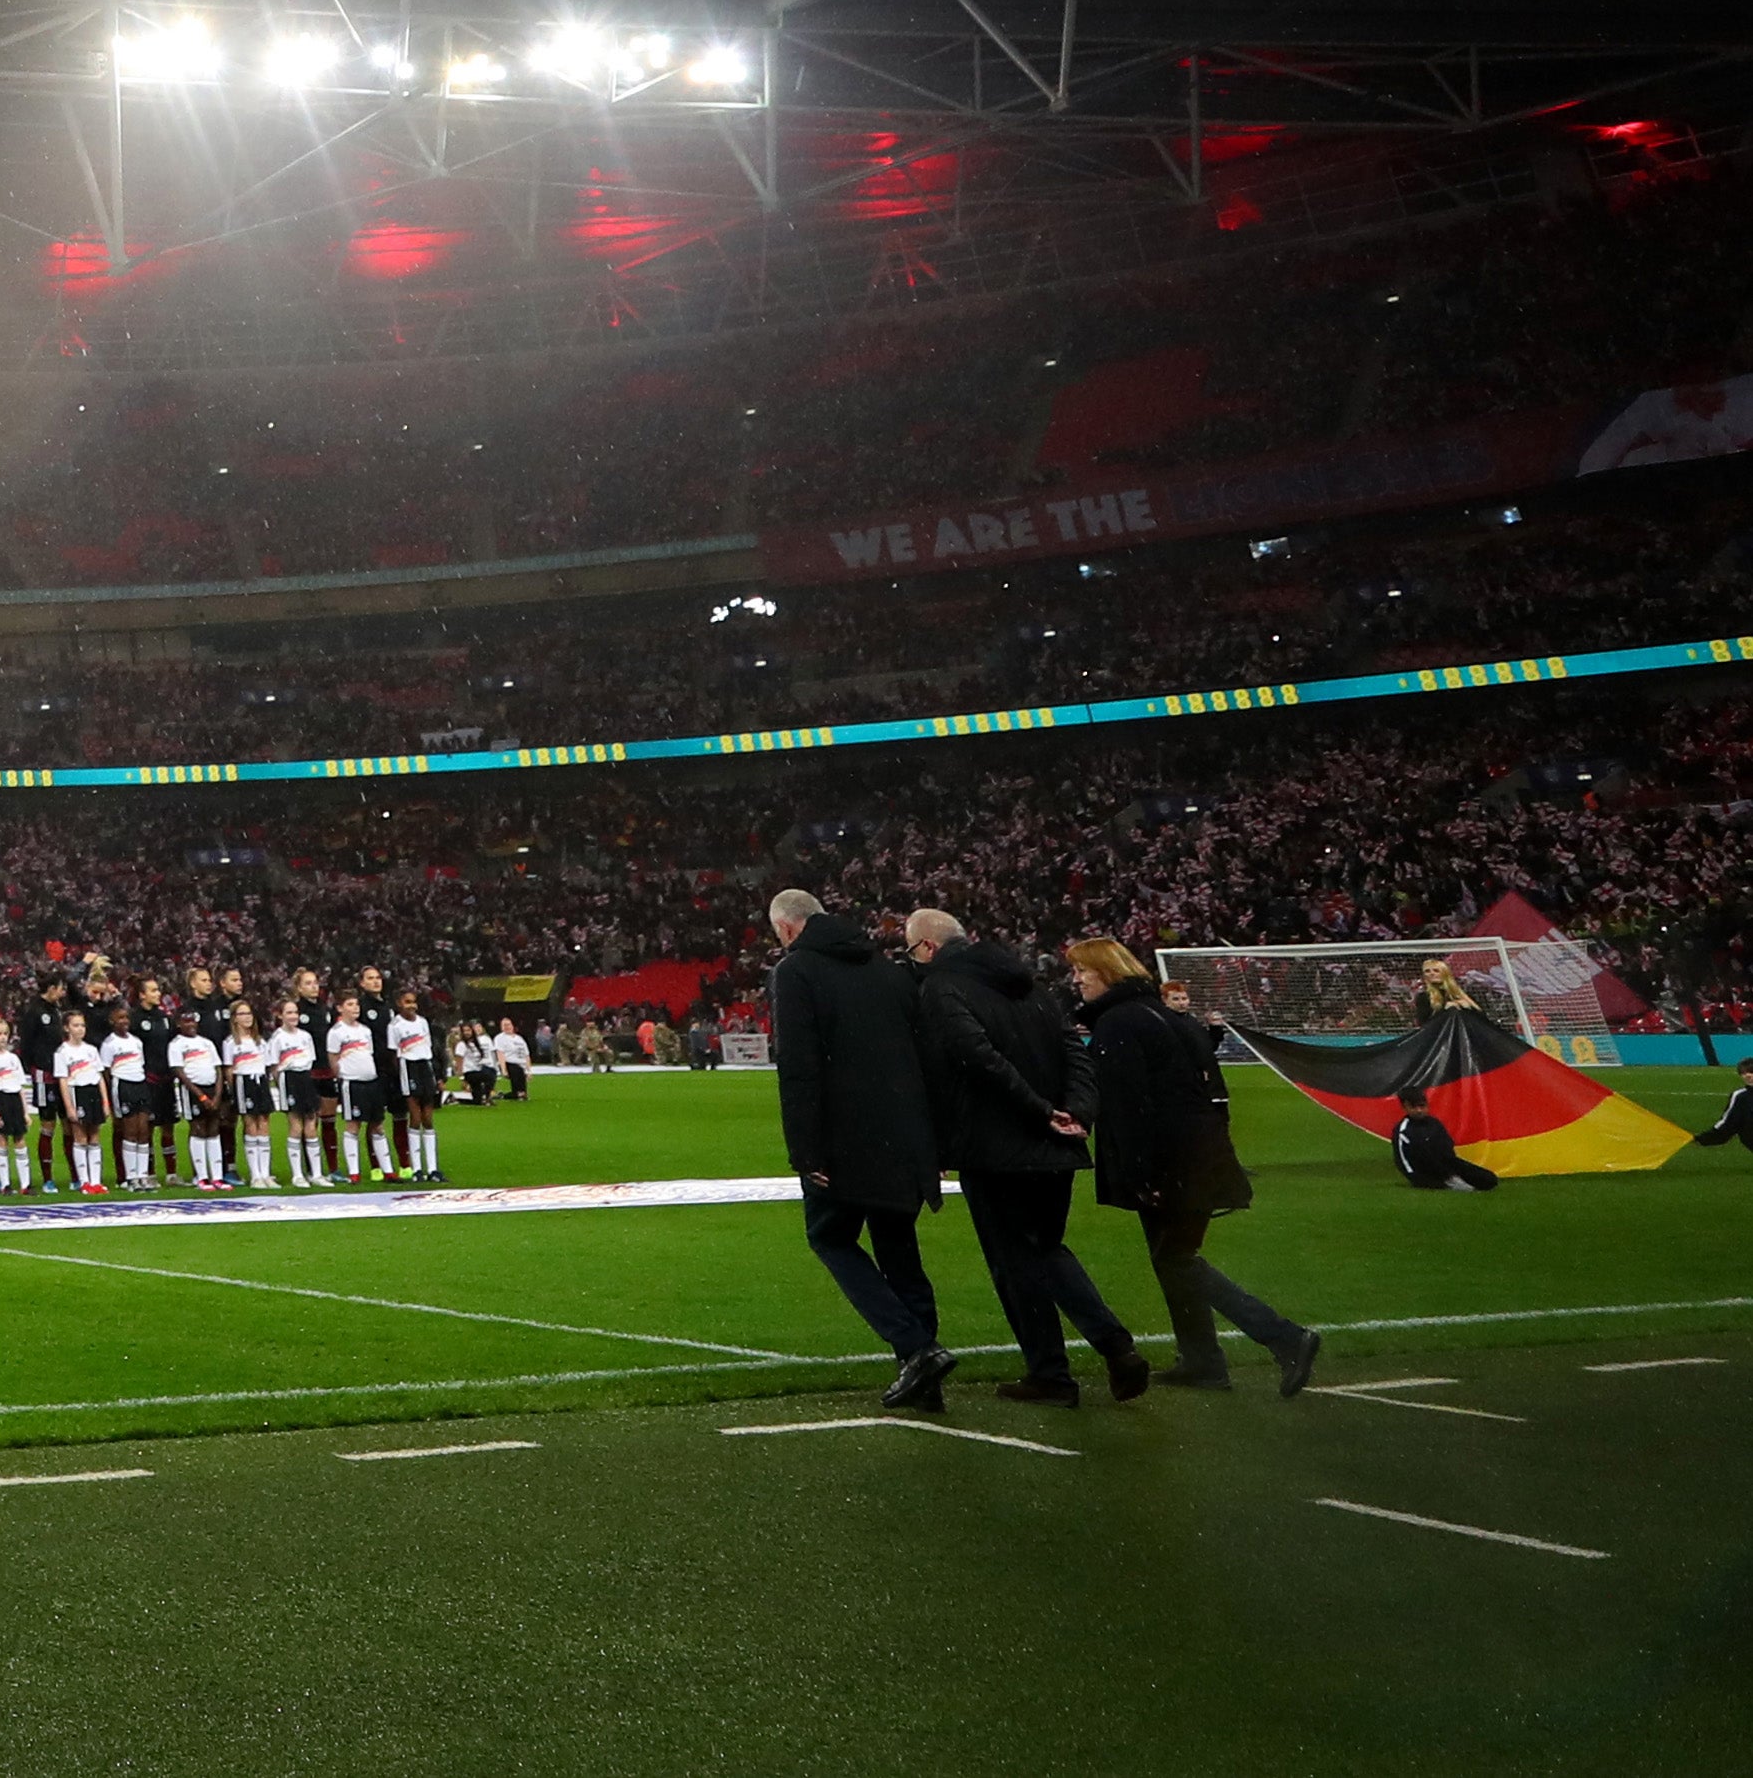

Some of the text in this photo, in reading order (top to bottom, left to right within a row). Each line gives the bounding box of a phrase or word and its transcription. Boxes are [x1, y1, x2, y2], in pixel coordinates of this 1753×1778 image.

[829, 489, 1157, 569] WE ARE THE
